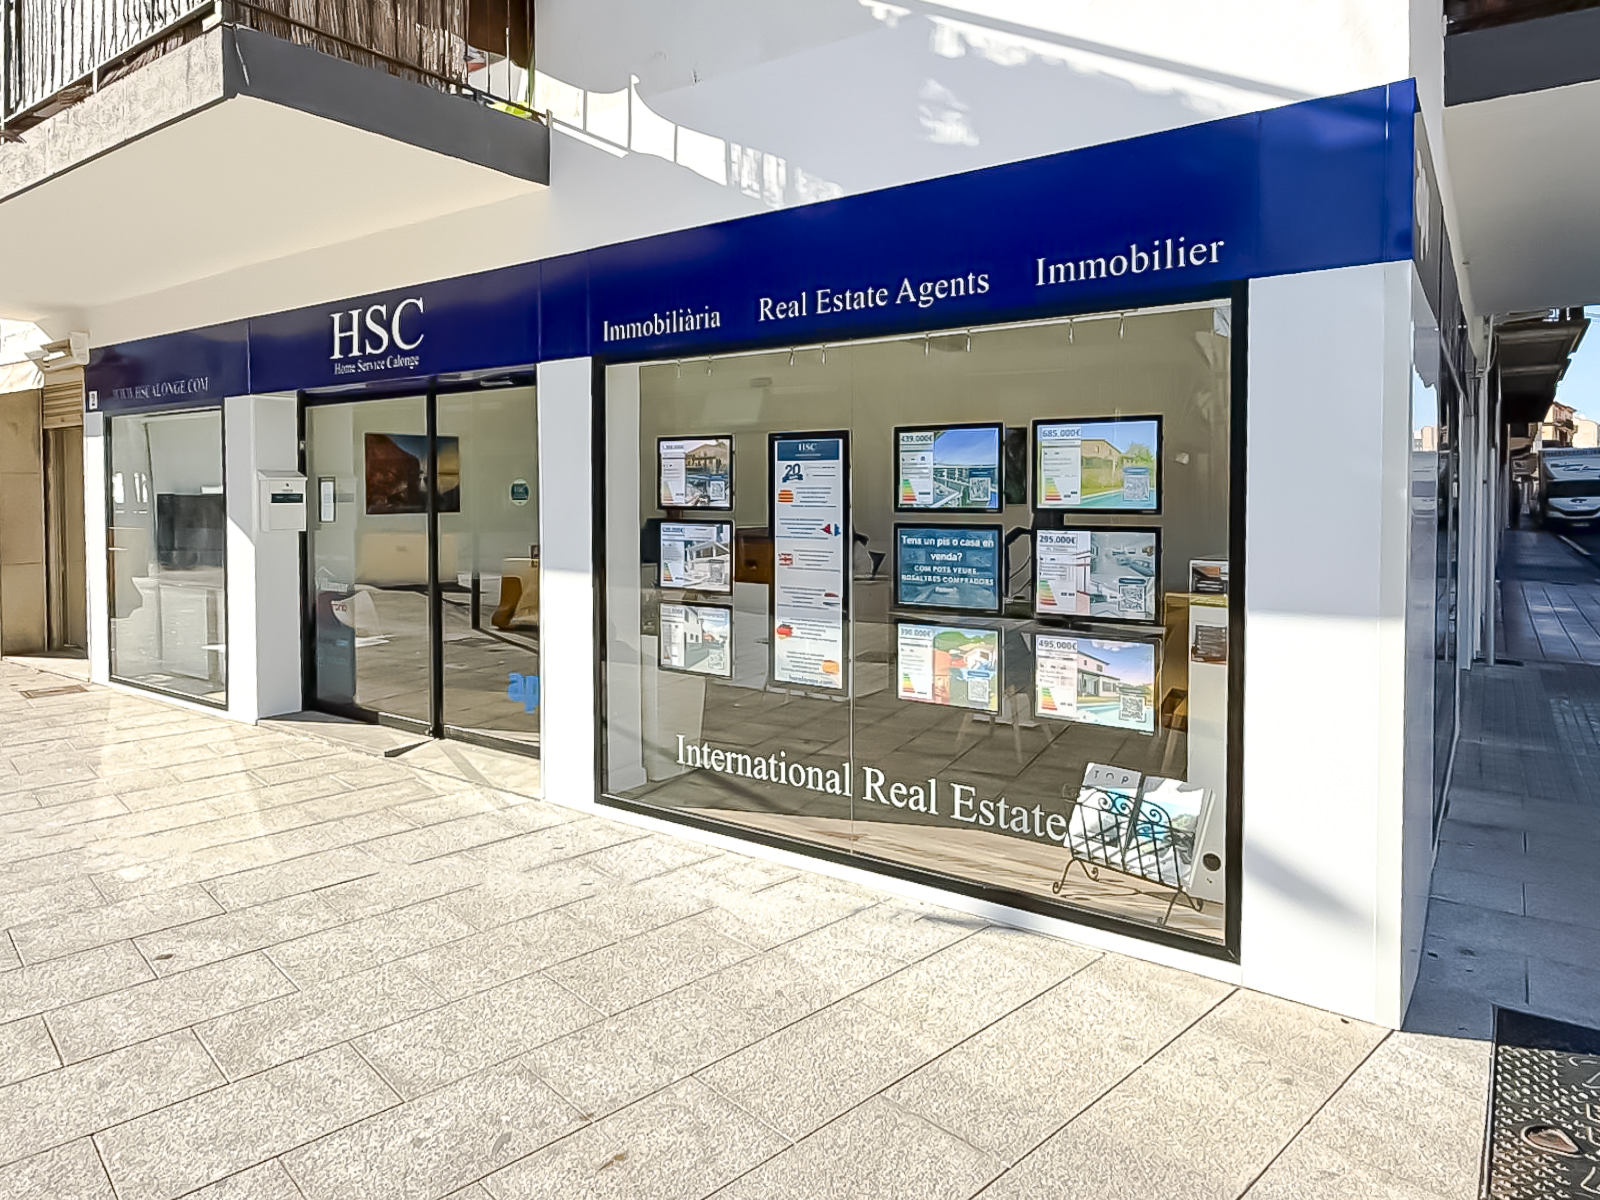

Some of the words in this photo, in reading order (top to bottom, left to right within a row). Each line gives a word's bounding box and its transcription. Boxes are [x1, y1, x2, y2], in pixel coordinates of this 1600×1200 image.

[1035, 236, 1225, 286] Immobilier
[758, 291, 807, 321] Real
[815, 286, 888, 314] Estate
[895, 272, 990, 308] Agents
[329, 296, 424, 359] HSC
[603, 305, 721, 342] Immobiliària
[334, 362, 356, 375] Home
[357, 359, 385, 373] Service
[386, 354, 419, 370] Calonge
[901, 535, 922, 545] Tens
[923, 537, 935, 546] un
[937, 537, 950, 548] pis
[960, 538, 980, 547] casa
[982, 539, 995, 547] en
[930, 551, 963, 562] venda?
[676, 733, 852, 797] International
[862, 766, 939, 815] Real
[950, 782, 1067, 841] Estate
